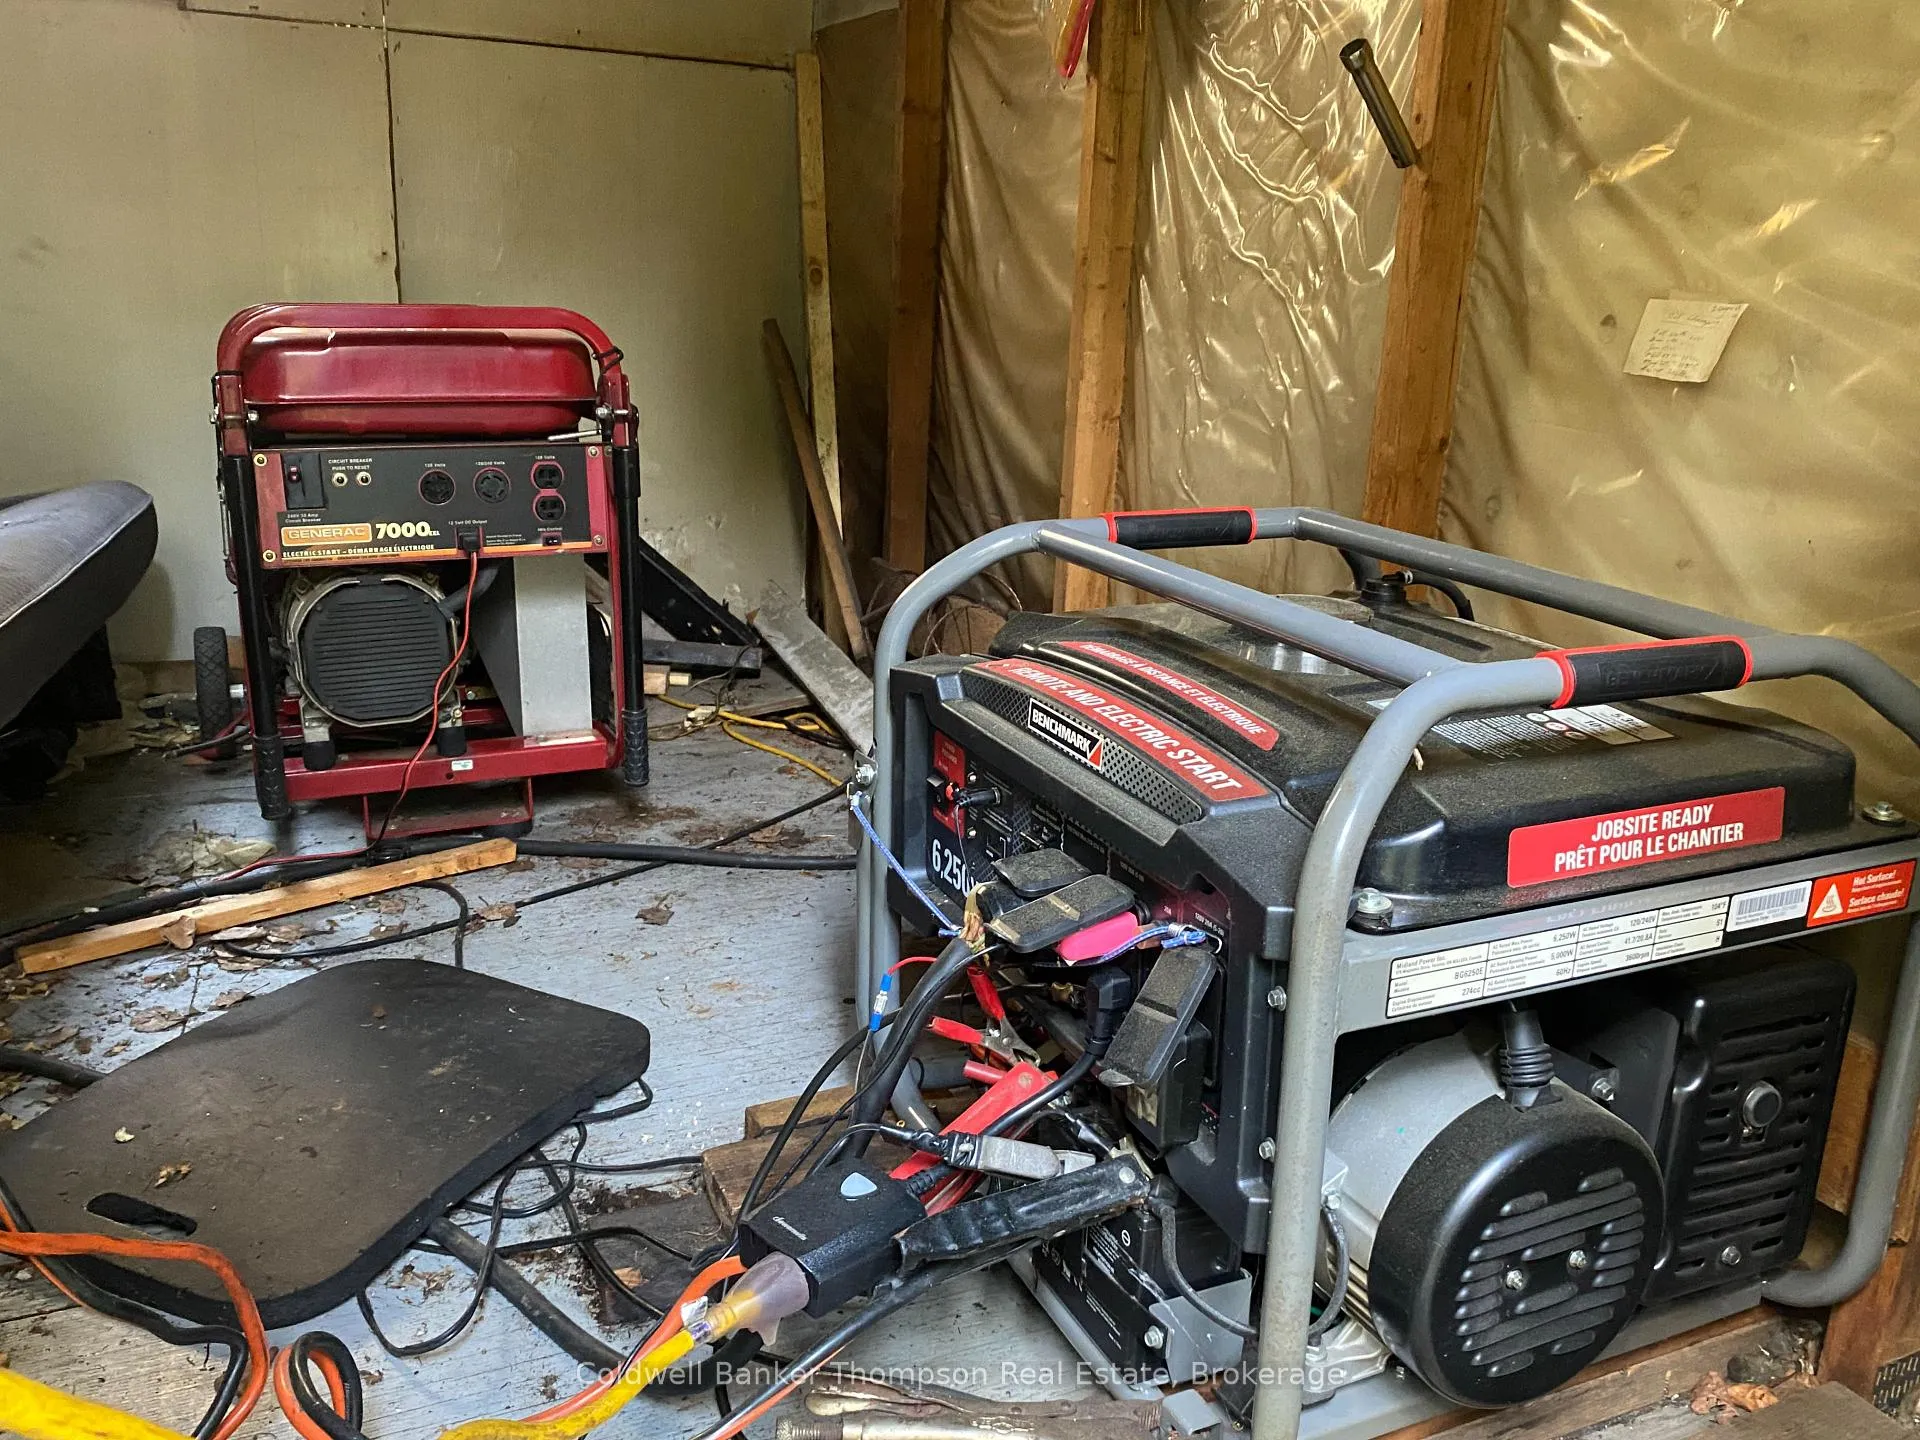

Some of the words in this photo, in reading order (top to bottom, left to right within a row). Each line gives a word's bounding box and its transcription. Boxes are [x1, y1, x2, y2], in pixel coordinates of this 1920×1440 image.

[287, 526, 366, 540] GENERAC
[375, 521, 431, 539] 7000
[283, 550, 317, 558] ELECTRIC
[393, 543, 435, 553] ÉLECTRIQUE
[1138, 666, 1193, 690] DISTANCE
[1183, 688, 1207, 697] ET
[1197, 696, 1268, 735] ÉLECTRIQUE
[1011, 667, 1071, 693] REMOTE
[1063, 682, 1107, 707] AND
[1096, 704, 1181, 750] ELECTRIC
[1167, 749, 1243, 791] START
[1032, 708, 1092, 754] BENCHMARK
[1591, 812, 1659, 843] JOBSITE
[1662, 803, 1714, 830] READY
[1554, 846, 1597, 873] PRÊT
[1599, 841, 1643, 865] POUR
[1646, 838, 1664, 857] LE
[1667, 822, 1744, 853] CHANTIER
[1853, 876, 1867, 886] Hot
[1866, 869, 1897, 884] Surface!
[1849, 895, 1877, 908] Surface
[1552, 931, 1577, 942] 6,250W
[1550, 949, 1574, 961] 5,000W
[1396, 958, 1418, 969] Midland
[1418, 956, 1437, 966] Power
[1454, 968, 1484, 981] BG6250E
[1555, 967, 1572, 977] 60Hz
[1461, 986, 1482, 997] 274cc
